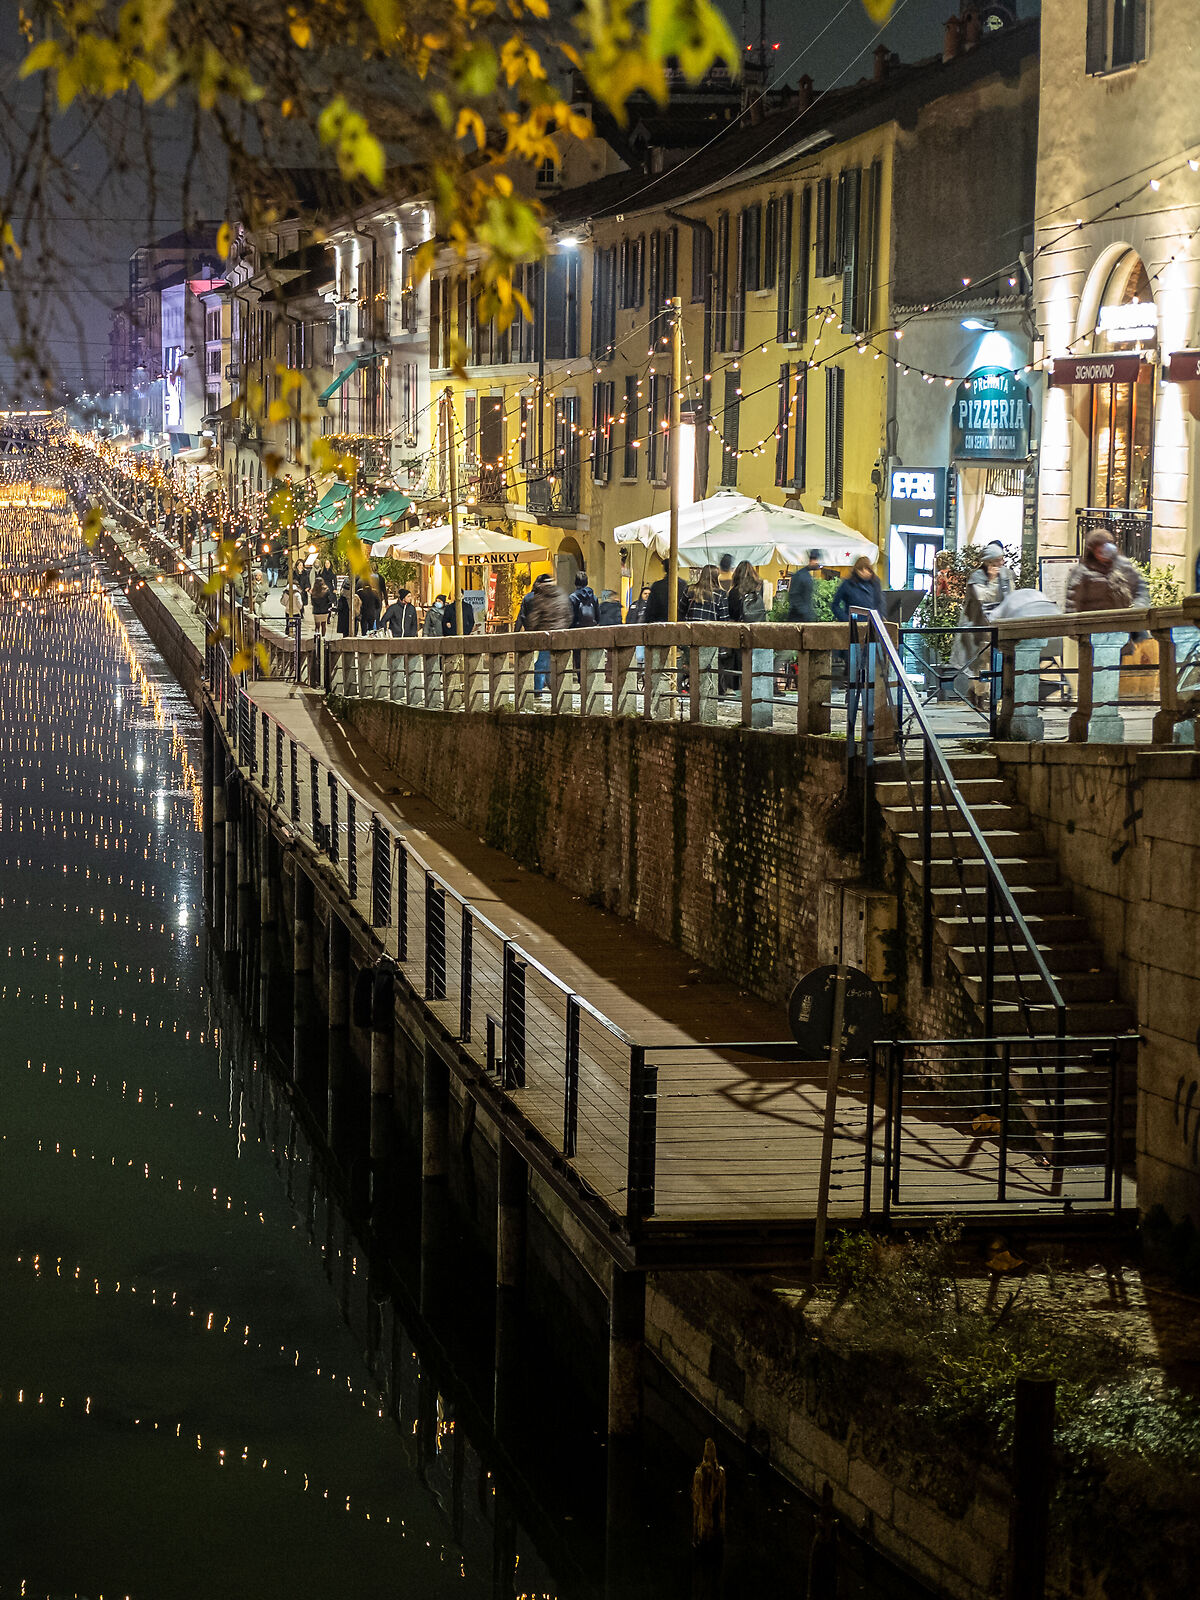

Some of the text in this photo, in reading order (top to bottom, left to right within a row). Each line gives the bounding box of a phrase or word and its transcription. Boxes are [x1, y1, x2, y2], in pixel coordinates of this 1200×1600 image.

[1075, 364, 1115, 380] SIGNORVINO
[959, 399, 1025, 429] PIZZERIA
[467, 553, 520, 564] FRANKLY
